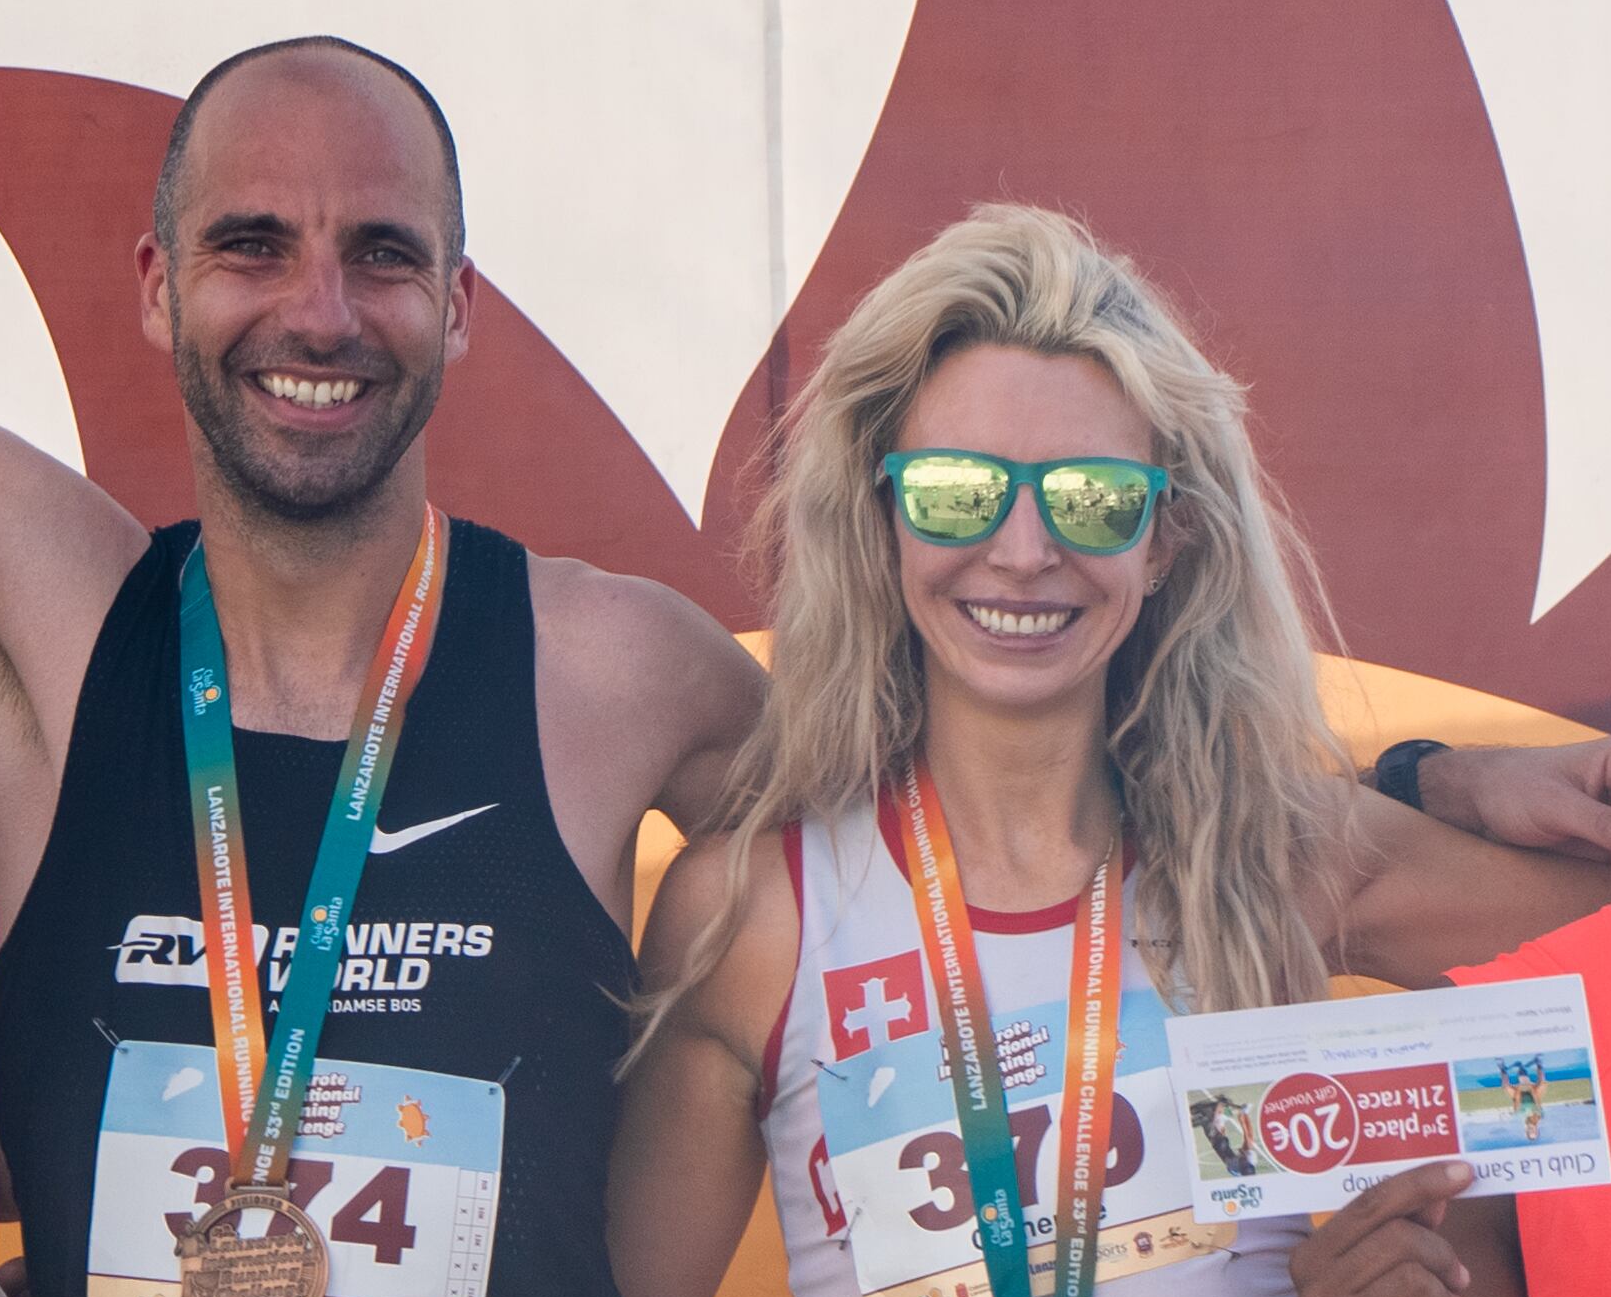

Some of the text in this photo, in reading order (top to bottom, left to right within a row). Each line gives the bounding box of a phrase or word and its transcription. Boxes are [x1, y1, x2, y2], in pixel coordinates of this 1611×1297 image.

[346, 598, 425, 822] LANZAROTE INTERNATIONAL
[207, 785, 233, 889] LANZAROTE
[214, 885, 248, 1034] INTERNATIONAL
[911, 808, 988, 1111] LANZAROTE INTERNATIONAL RUNNING
[390, 998, 422, 1013] BOS
[1080, 999, 1103, 1081] RUNNING
[275, 1028, 305, 1101] EDITION
[1264, 1084, 1338, 1115] Gift Voucher
[1357, 1084, 1446, 1112] 21k race
[1074, 1082, 1098, 1191] CHALLENGE
[1266, 1103, 1349, 1160] 20€
[1363, 1114, 1450, 1144] 3rd place
[1520, 1153, 1596, 1178] Club La
